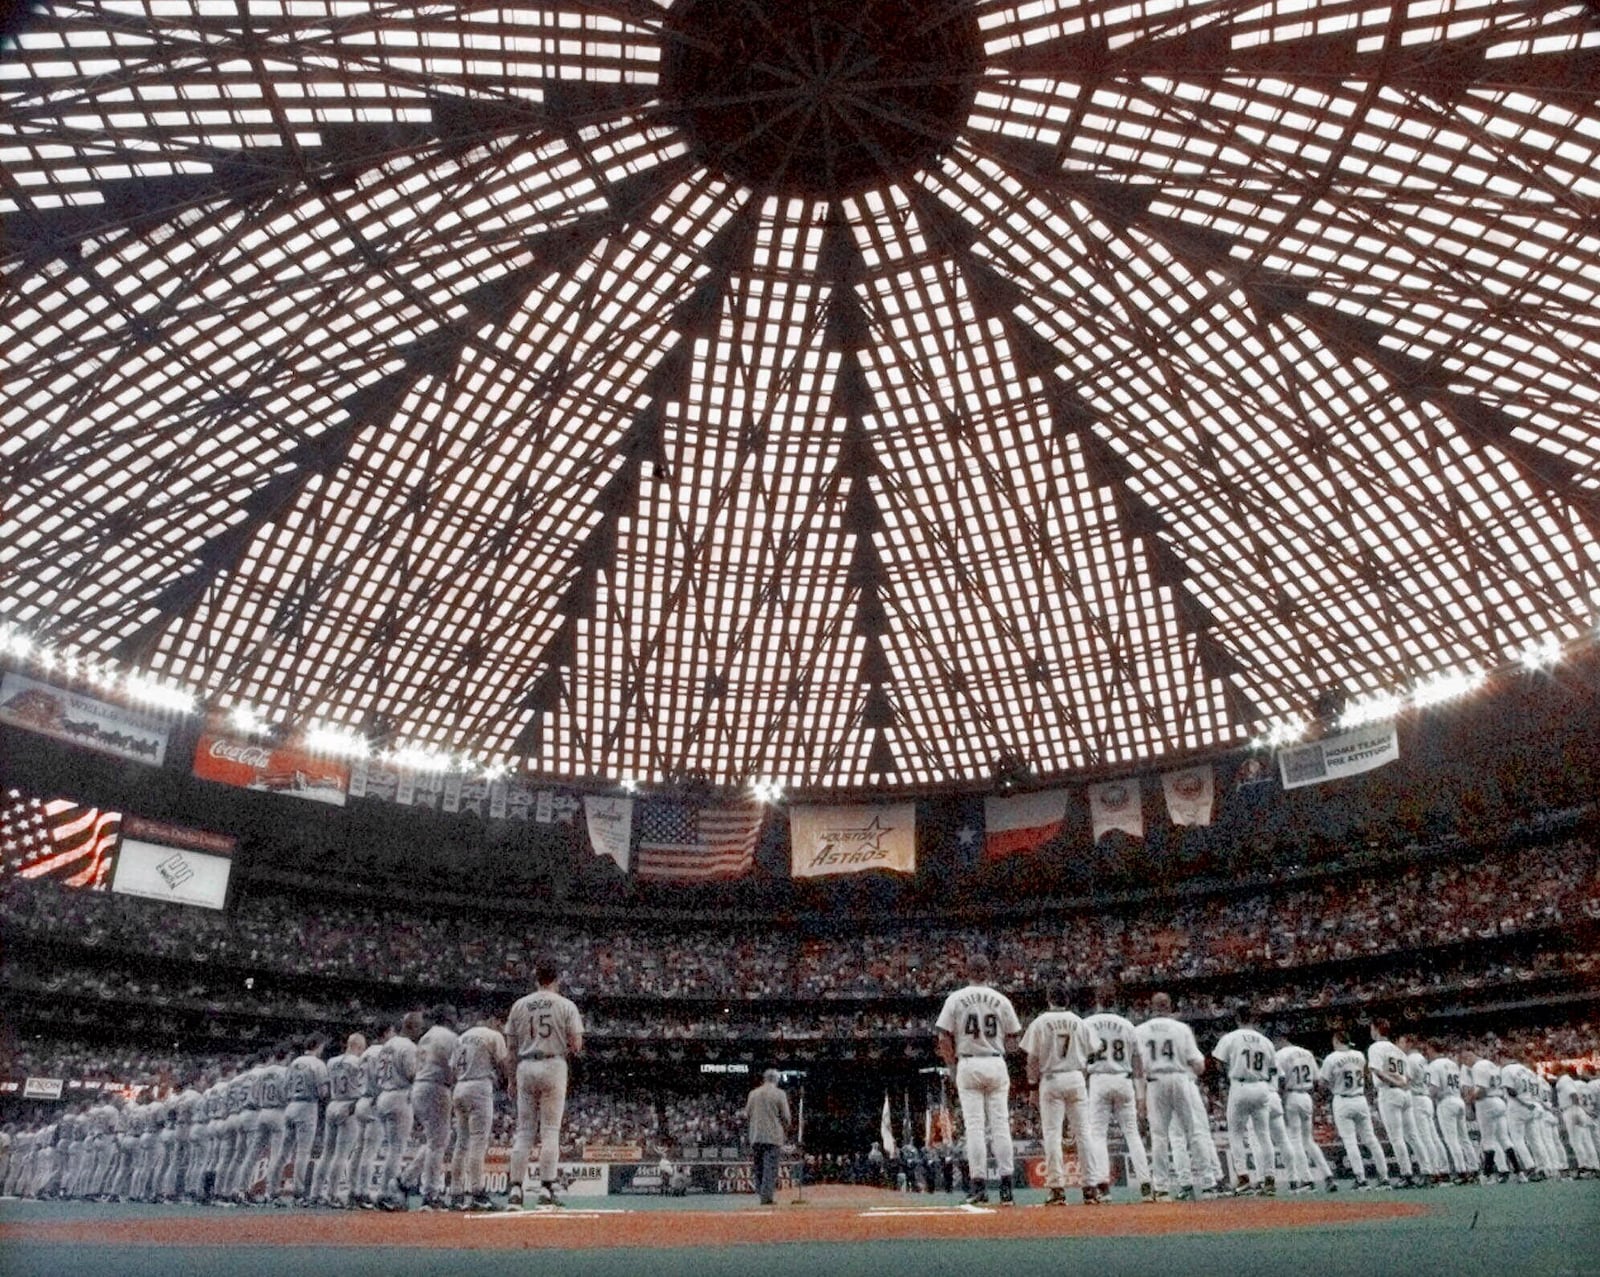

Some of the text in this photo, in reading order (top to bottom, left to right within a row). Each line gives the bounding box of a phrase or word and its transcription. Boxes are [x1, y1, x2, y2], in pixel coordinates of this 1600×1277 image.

[820, 831, 876, 843] HOUSTON
[529, 1014, 552, 1039] 15
[964, 1013, 998, 1039] 49
[1057, 1033, 1070, 1058] 7
[1096, 1037, 1124, 1062] 28
[1145, 1039, 1174, 1061] 14
[1241, 1048, 1264, 1072] 18
[1388, 1056, 1404, 1076] 50
[1292, 1064, 1311, 1085] 12
